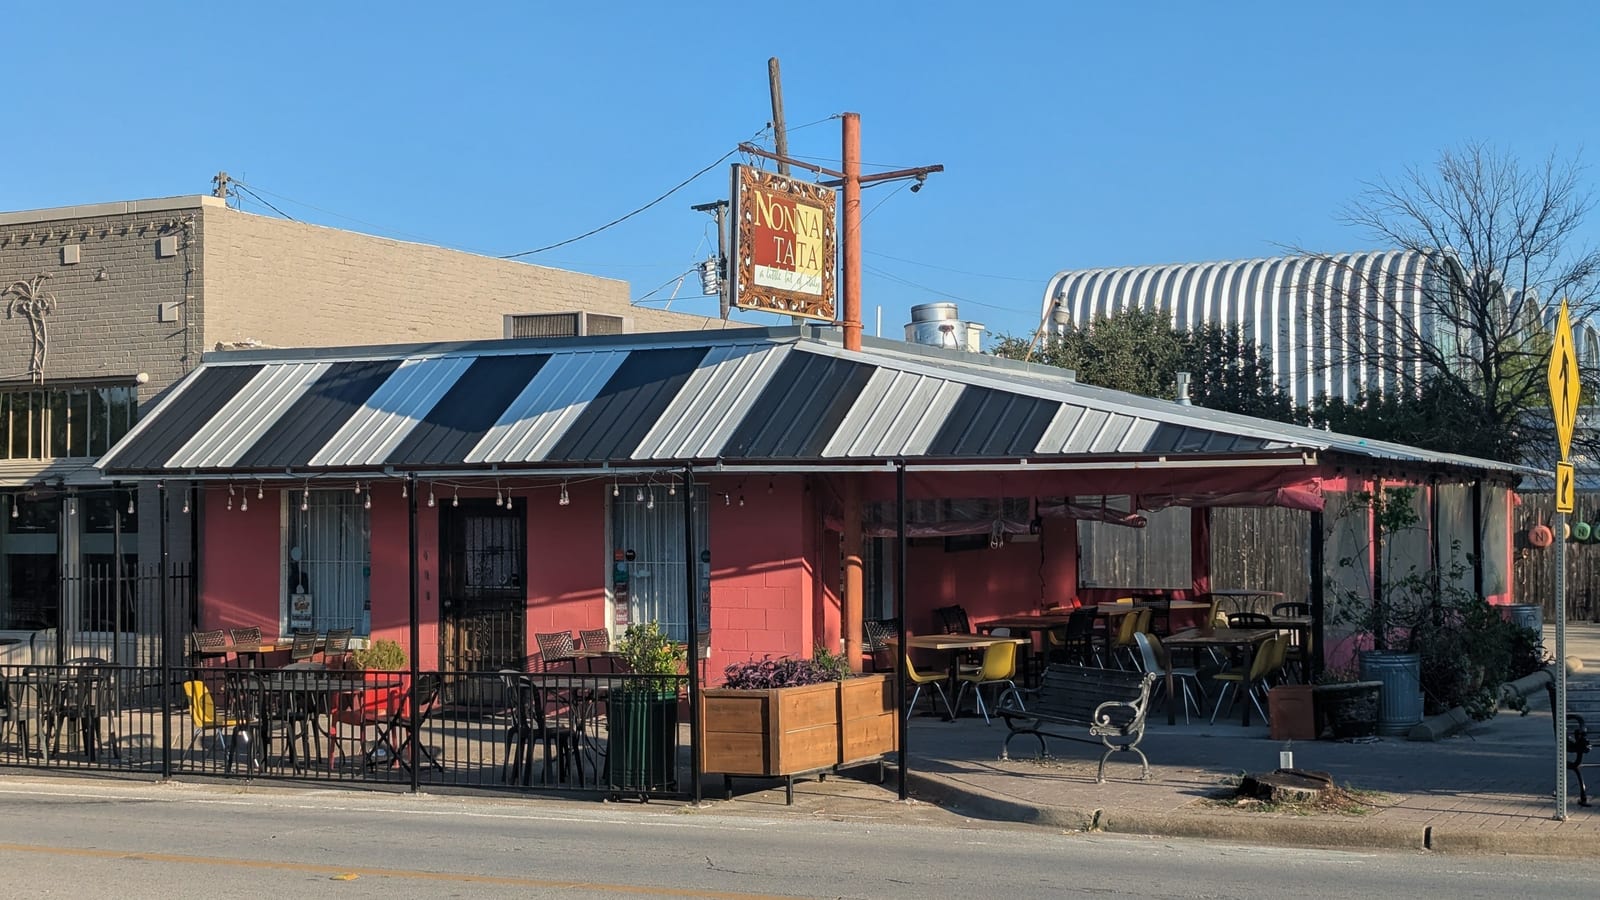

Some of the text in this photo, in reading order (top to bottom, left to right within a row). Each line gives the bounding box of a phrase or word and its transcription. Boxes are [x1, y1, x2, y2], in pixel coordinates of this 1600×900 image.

[754, 190, 821, 239] NONNA
[773, 236, 818, 270] TATA
[1535, 531, 1544, 542] N
